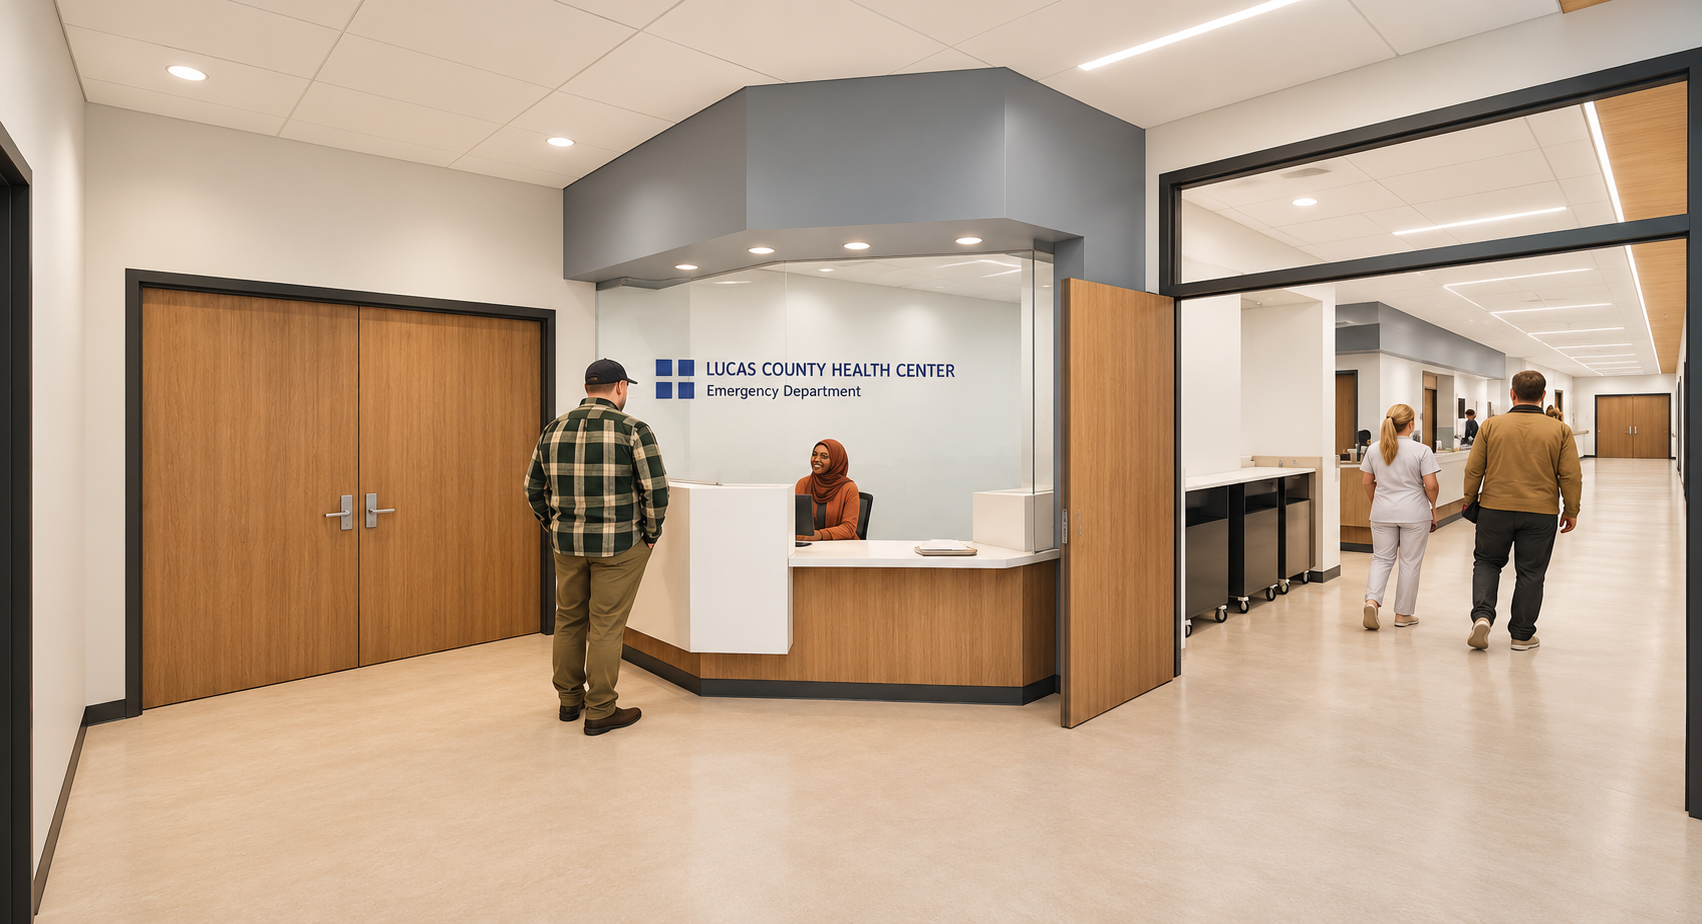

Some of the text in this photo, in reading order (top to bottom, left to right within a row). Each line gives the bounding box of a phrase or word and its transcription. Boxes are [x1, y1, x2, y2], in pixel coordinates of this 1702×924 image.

[706, 361, 956, 378] LUCAS COUNTY HEALTH CENTER
[706, 384, 861, 400] Emergency Department
